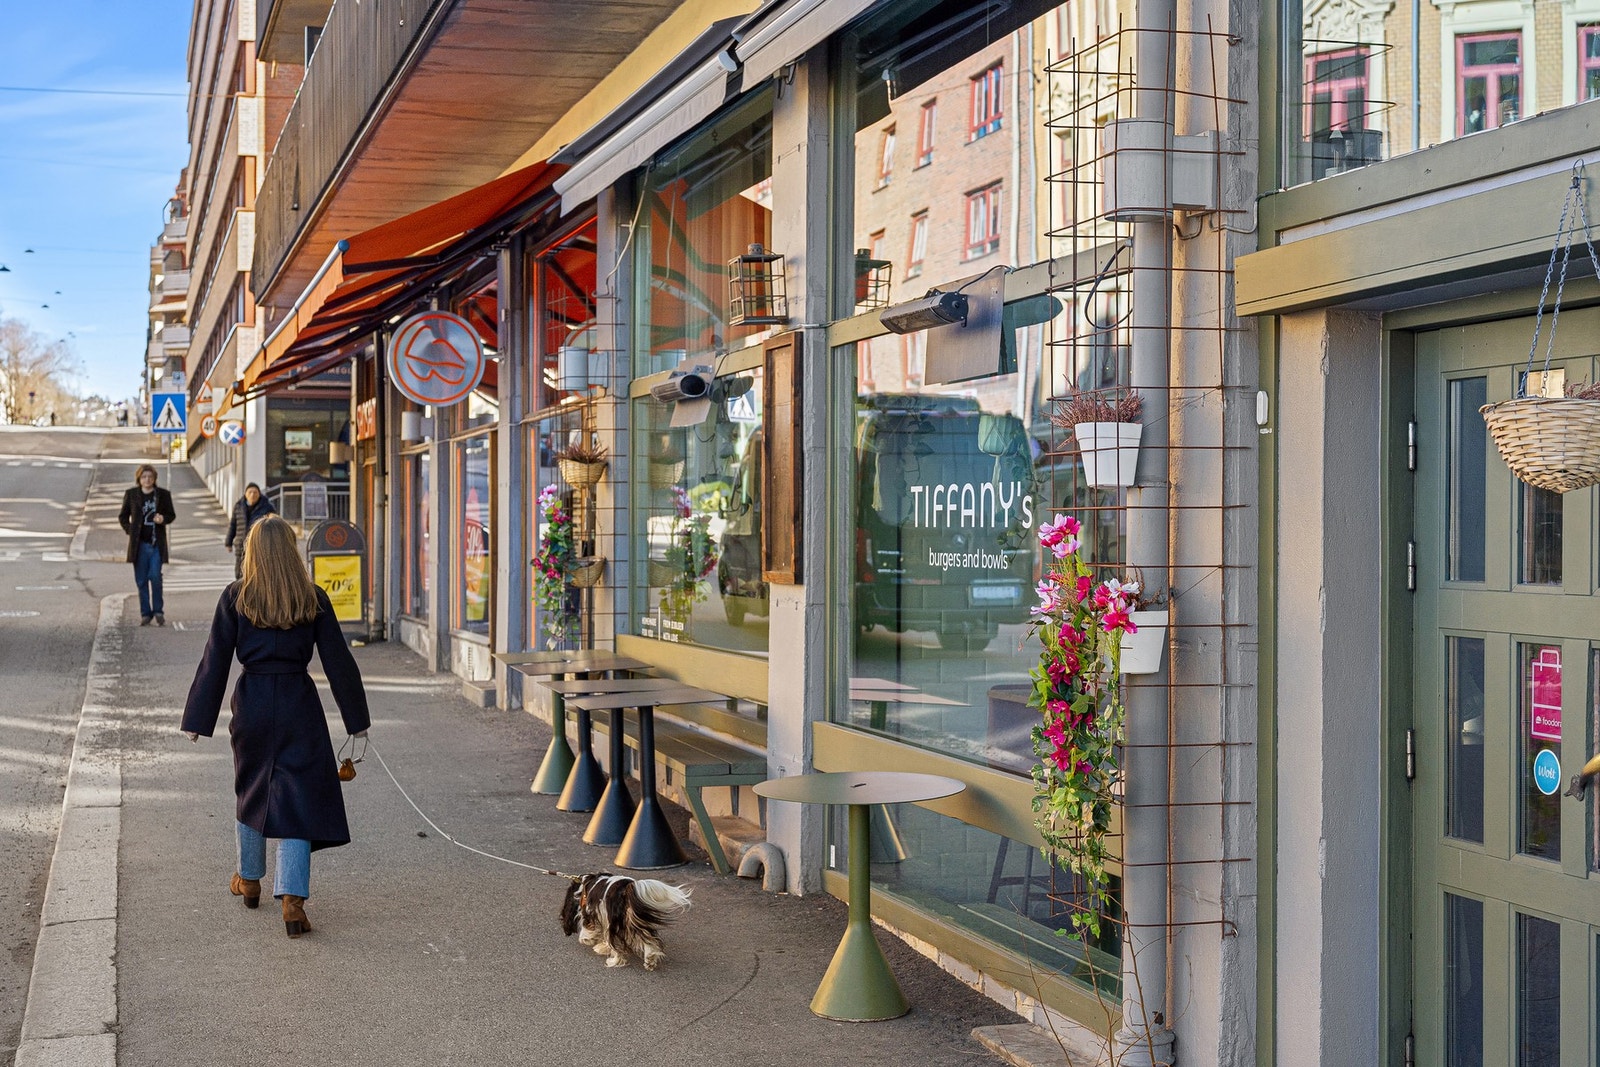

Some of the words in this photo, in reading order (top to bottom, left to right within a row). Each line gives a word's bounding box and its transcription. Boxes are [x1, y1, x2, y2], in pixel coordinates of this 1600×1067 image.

[204, 420, 215, 431] 40
[910, 481, 1033, 529] TIFFANY's
[929, 547, 961, 572] burgers
[962, 549, 980, 568] and
[981, 549, 1008, 570] bowls
[322, 579, 354, 592] 70%
[1538, 765, 1556, 780] Wolt
